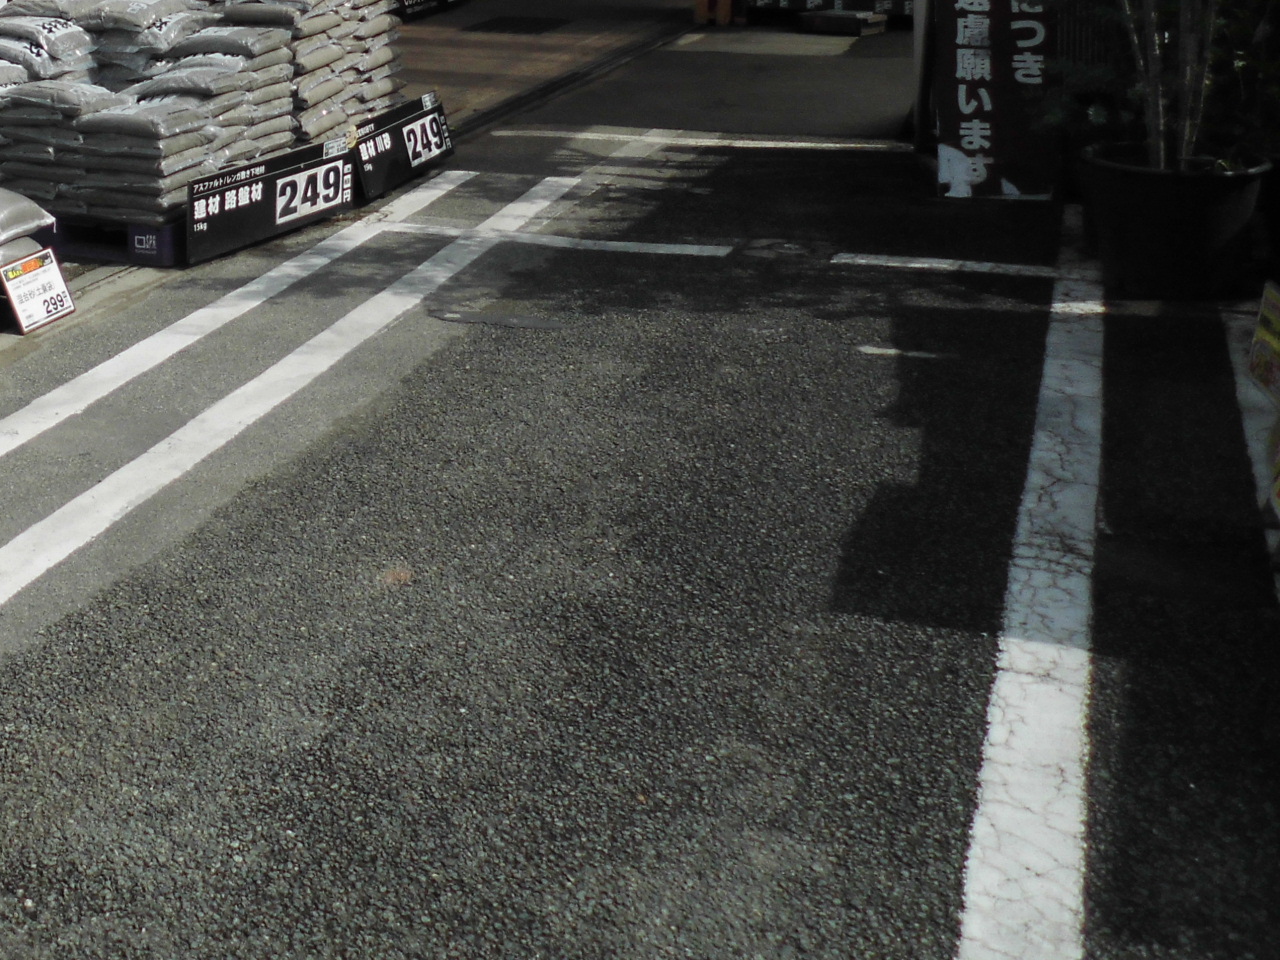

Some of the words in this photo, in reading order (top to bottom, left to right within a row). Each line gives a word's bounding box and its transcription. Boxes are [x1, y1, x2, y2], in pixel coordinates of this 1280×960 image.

[406, 116, 444, 161] 249
[193, 194, 219, 220] 建材
[224, 183, 264, 210] 路盤材
[278, 164, 341, 219] 249
[193, 223, 208, 232] 15kg
[42, 293, 66, 315] 299
